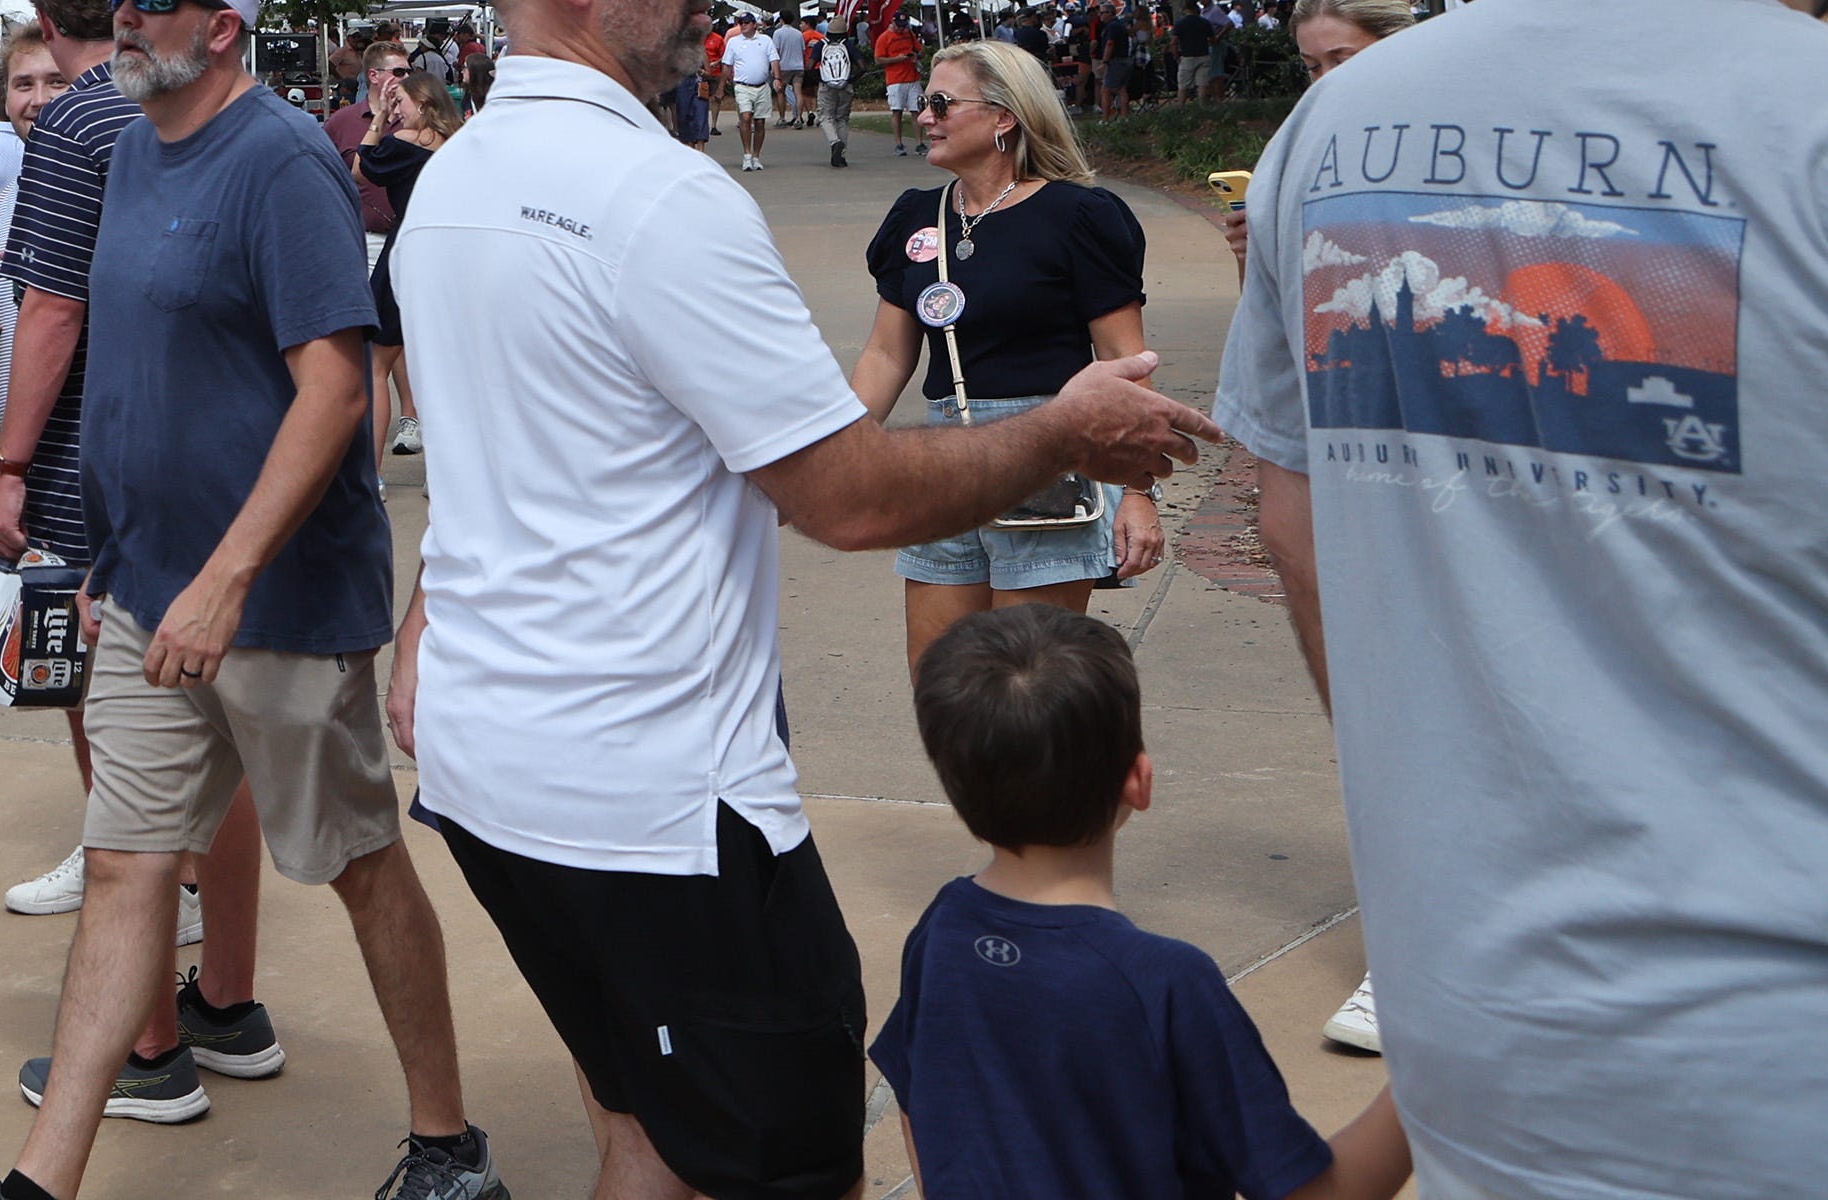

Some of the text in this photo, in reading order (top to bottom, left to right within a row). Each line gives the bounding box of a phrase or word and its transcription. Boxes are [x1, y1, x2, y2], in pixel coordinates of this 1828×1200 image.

[1309, 123, 1718, 207] AUBURN
[43, 606, 70, 654] Lite
[53, 661, 67, 686] Lite
[74, 661, 83, 673] 12
